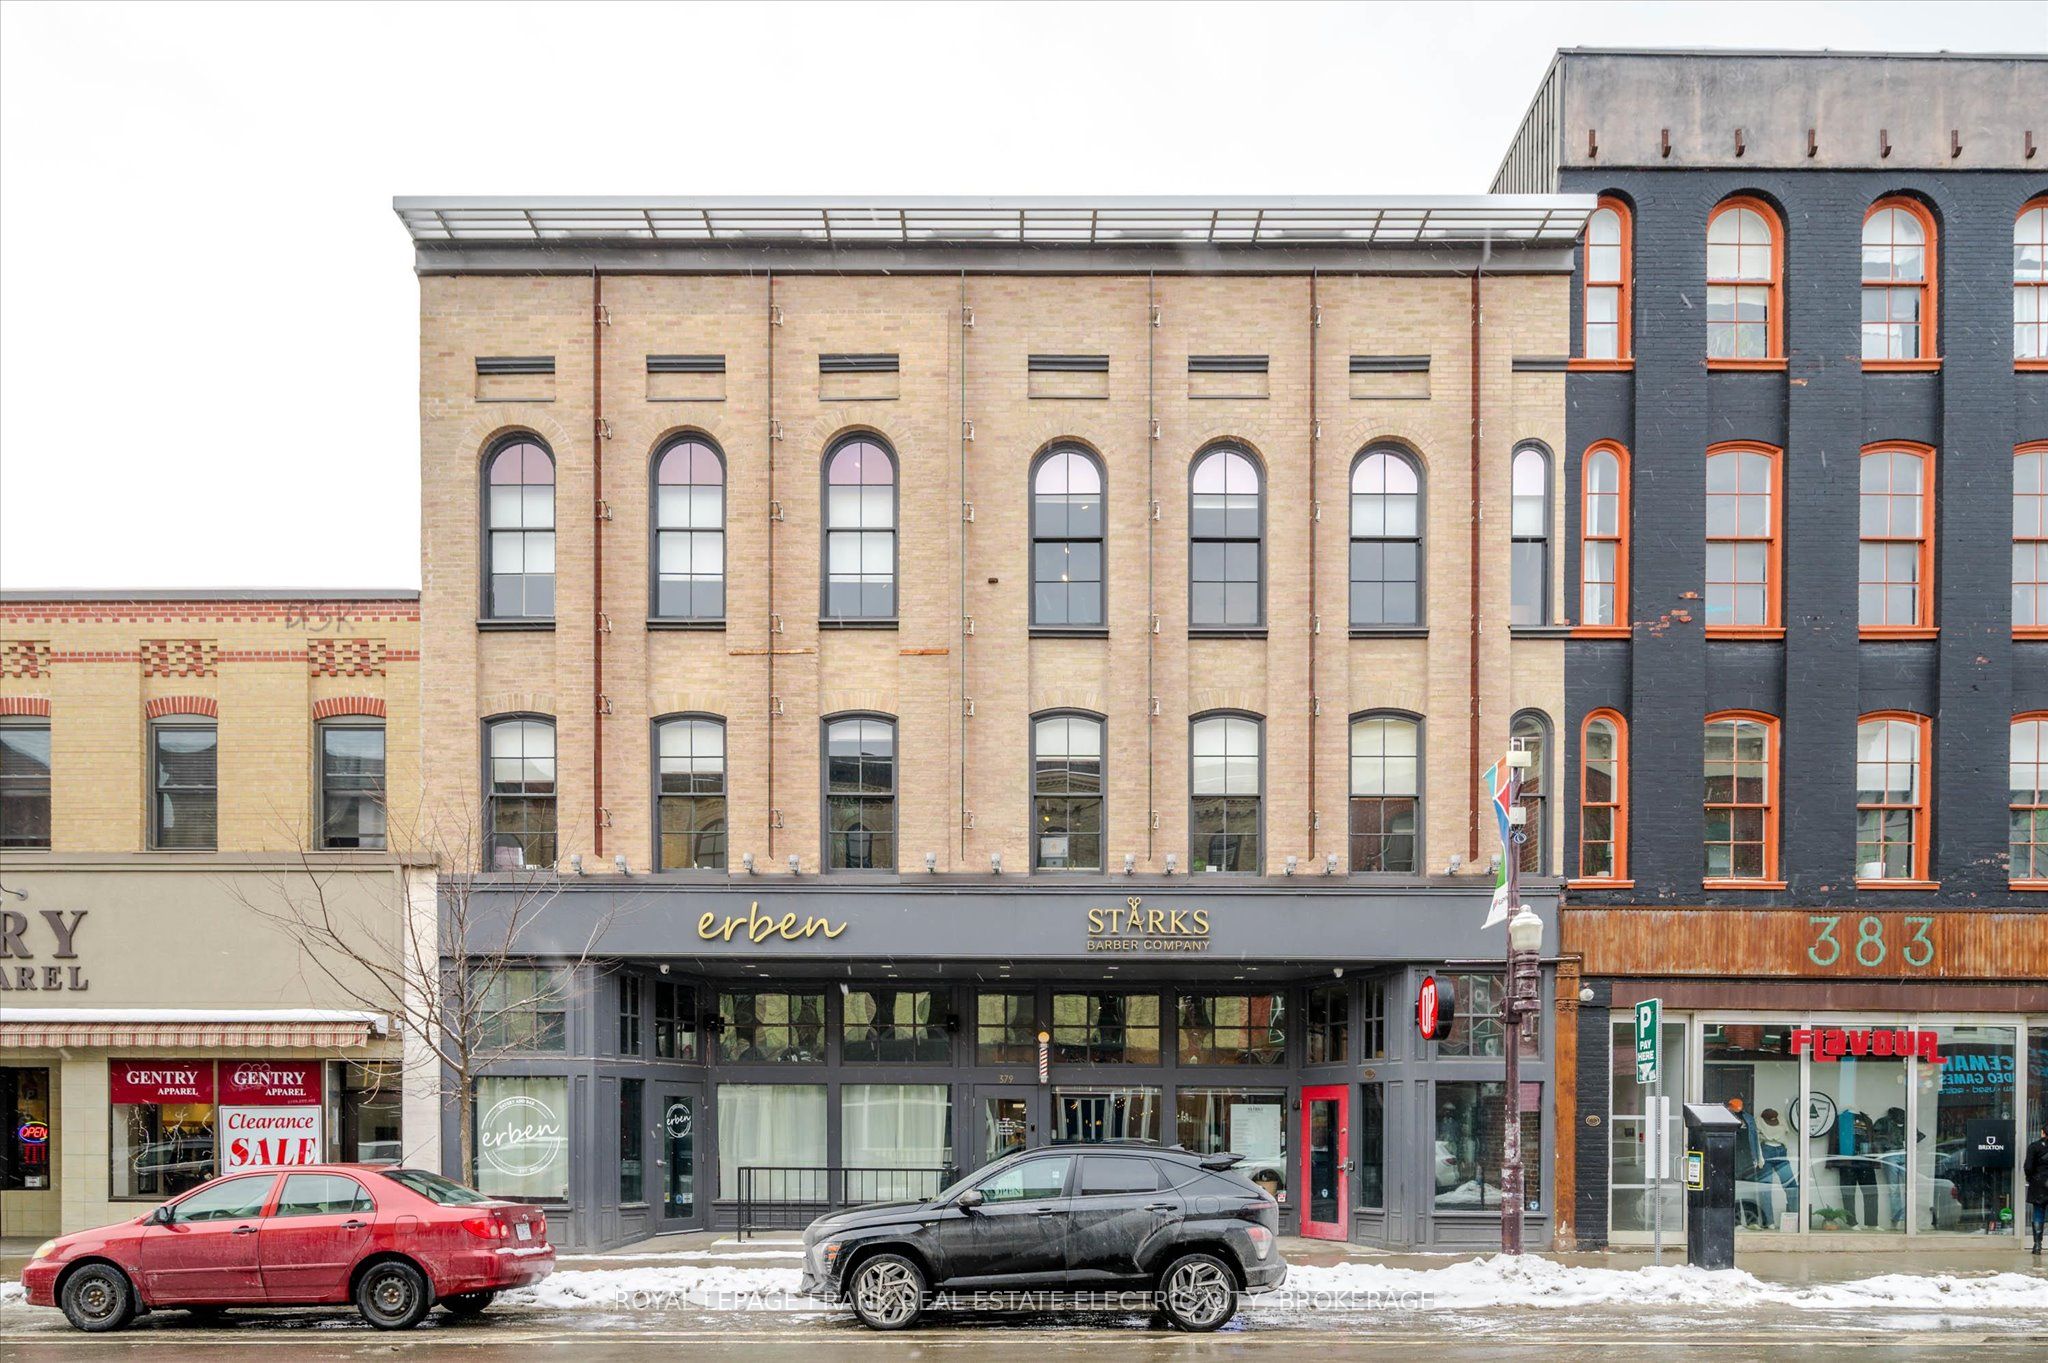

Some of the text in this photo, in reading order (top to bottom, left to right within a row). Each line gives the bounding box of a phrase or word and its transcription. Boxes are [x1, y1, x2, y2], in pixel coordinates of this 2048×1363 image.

[698, 900, 848, 943] erben
[1088, 897, 1210, 934] STARKS
[0, 910, 88, 959] RY
[1808, 915, 1936, 967] 383
[1087, 940, 1210, 950] BARBER COMPANY
[1640, 1005, 1652, 1039] P
[1639, 1039, 1653, 1052] PAY
[1637, 1050, 1655, 1062] HERE
[126, 1070, 199, 1085] GENTRY
[233, 1070, 306, 1085] GENTRY
[1000, 1075, 1014, 1084] 379
[157, 1087, 199, 1096] APPAREL
[265, 1087, 307, 1096] APPAREL
[228, 1113, 314, 1130] Clearance
[666, 1114, 692, 1126] erben
[21, 1127, 48, 1138] OPEN
[482, 1122, 560, 1147] erben
[229, 1136, 316, 1167] SALE
